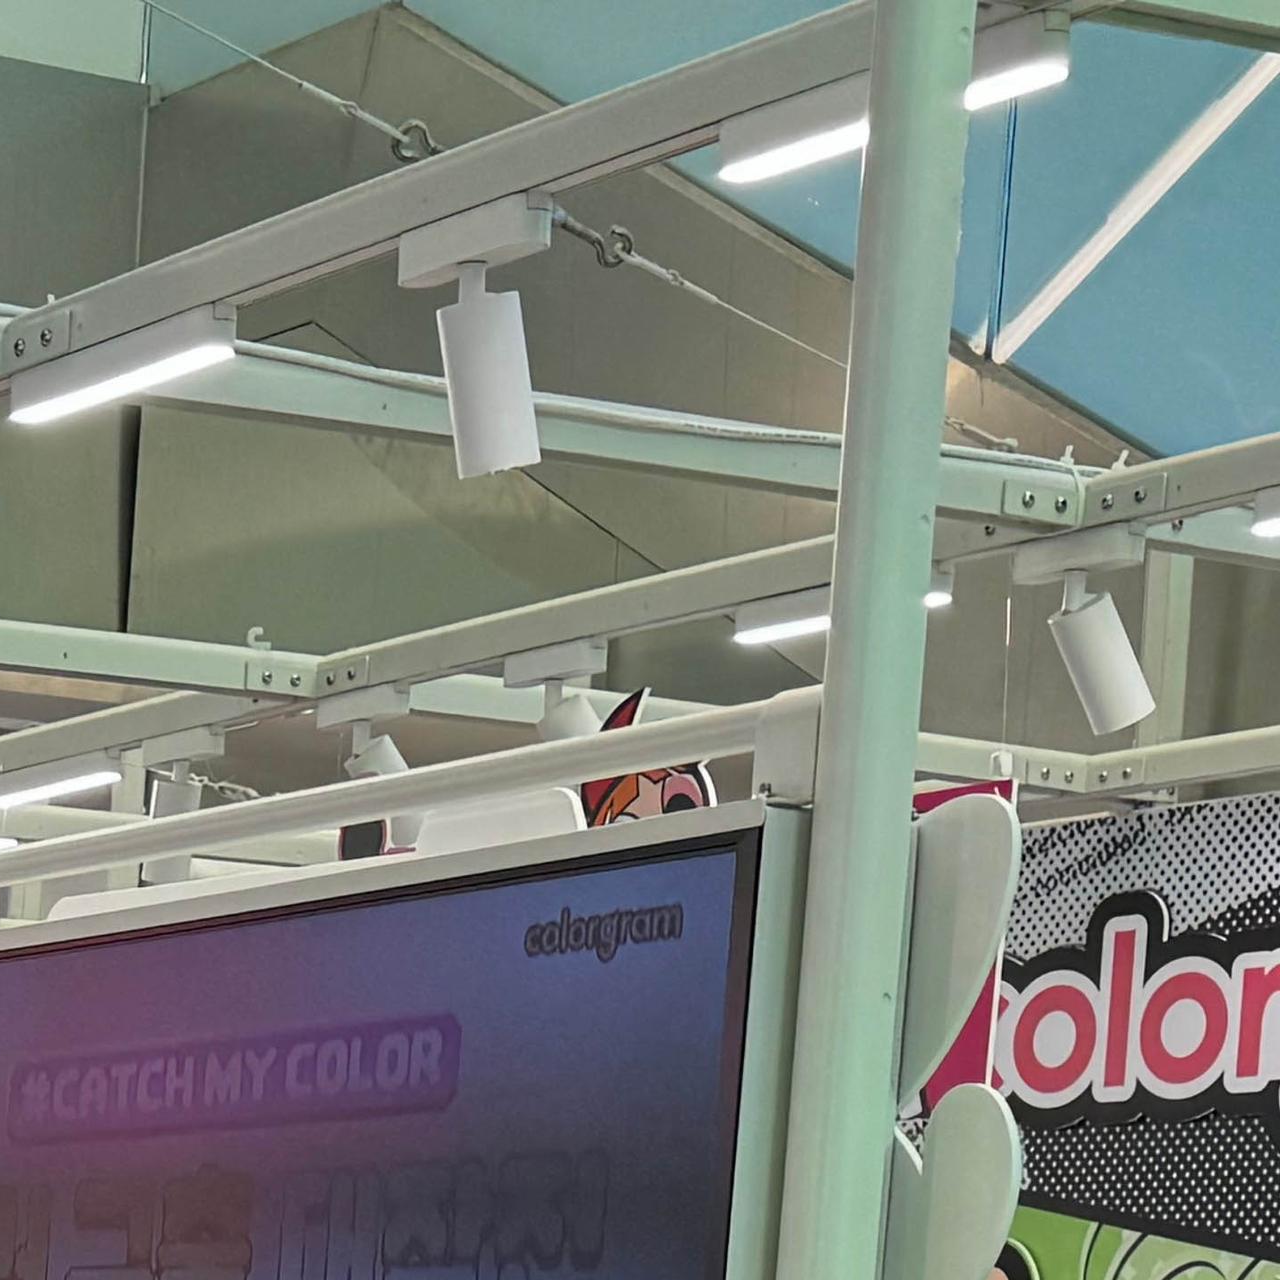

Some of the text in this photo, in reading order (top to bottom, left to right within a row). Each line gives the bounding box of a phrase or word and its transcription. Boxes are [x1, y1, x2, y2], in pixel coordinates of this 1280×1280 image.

[524, 903, 682, 962] colorgram
[1002, 928, 1280, 1093] olor
[202, 1042, 277, 1108] MY
[285, 1029, 443, 1092] COLOR
